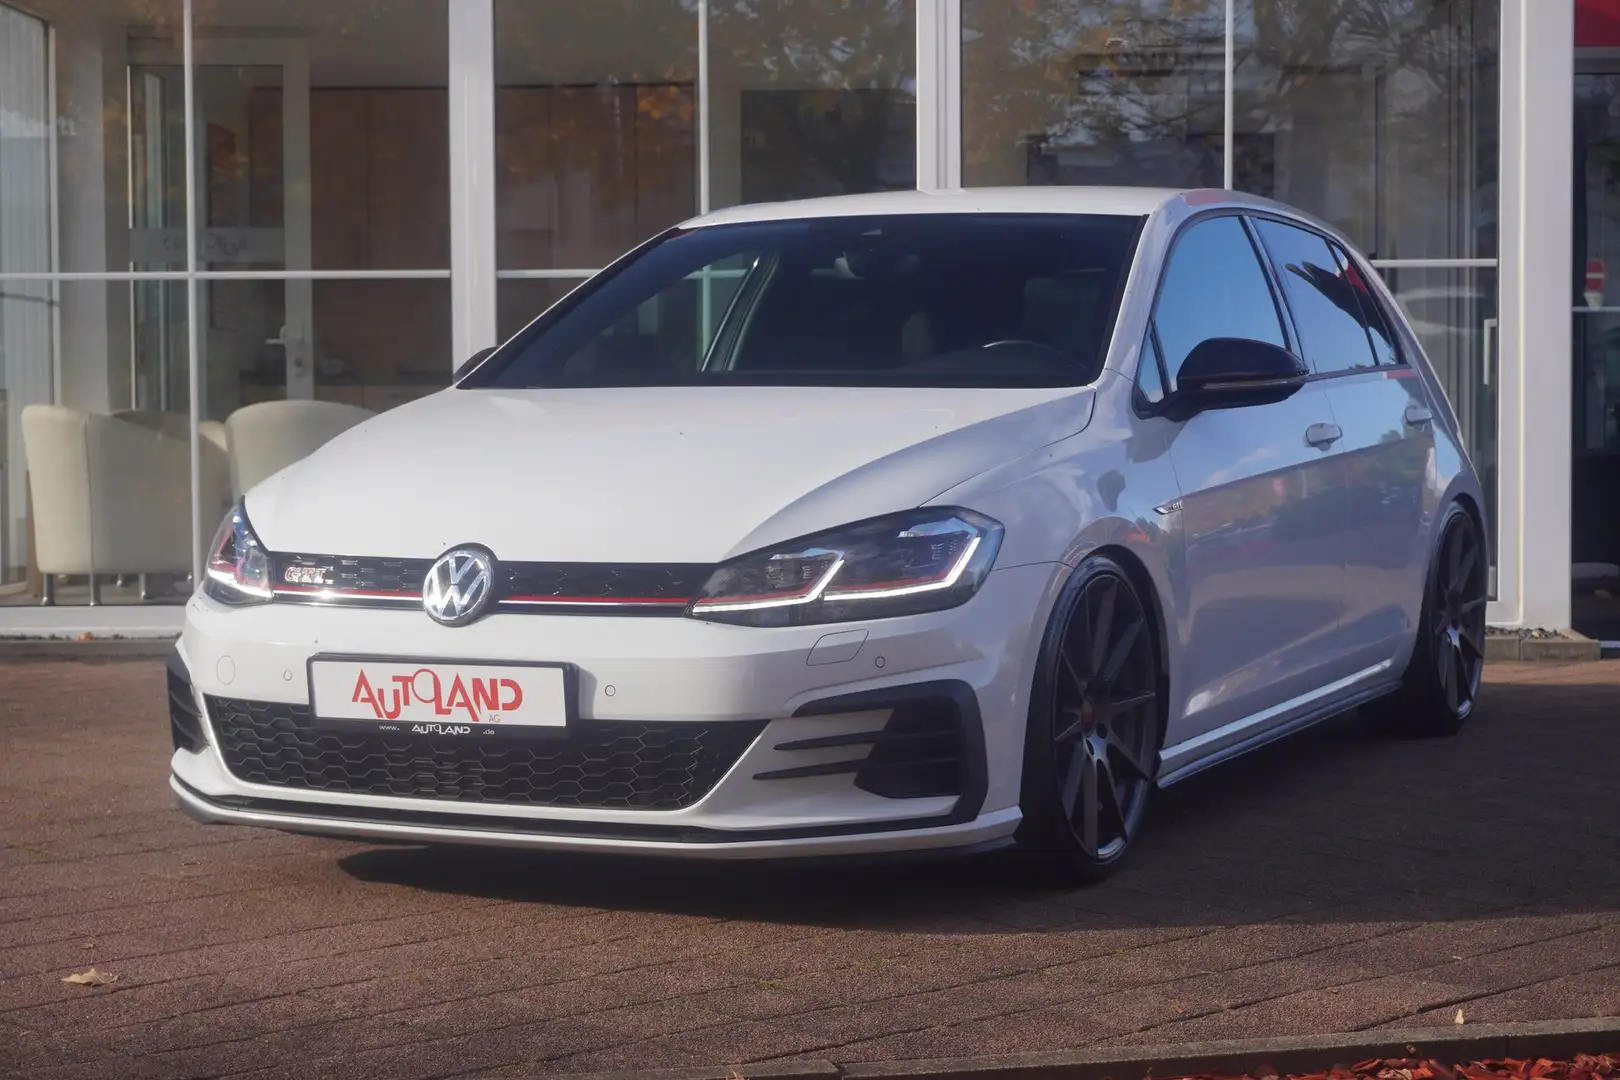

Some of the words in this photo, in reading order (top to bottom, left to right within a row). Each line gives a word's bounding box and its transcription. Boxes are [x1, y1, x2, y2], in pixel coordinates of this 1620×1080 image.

[284, 566, 327, 584] GTI
[351, 668, 523, 722] AUTOLAND
[488, 714, 501, 723] AG
[411, 723, 471, 735] AUTOLAND
